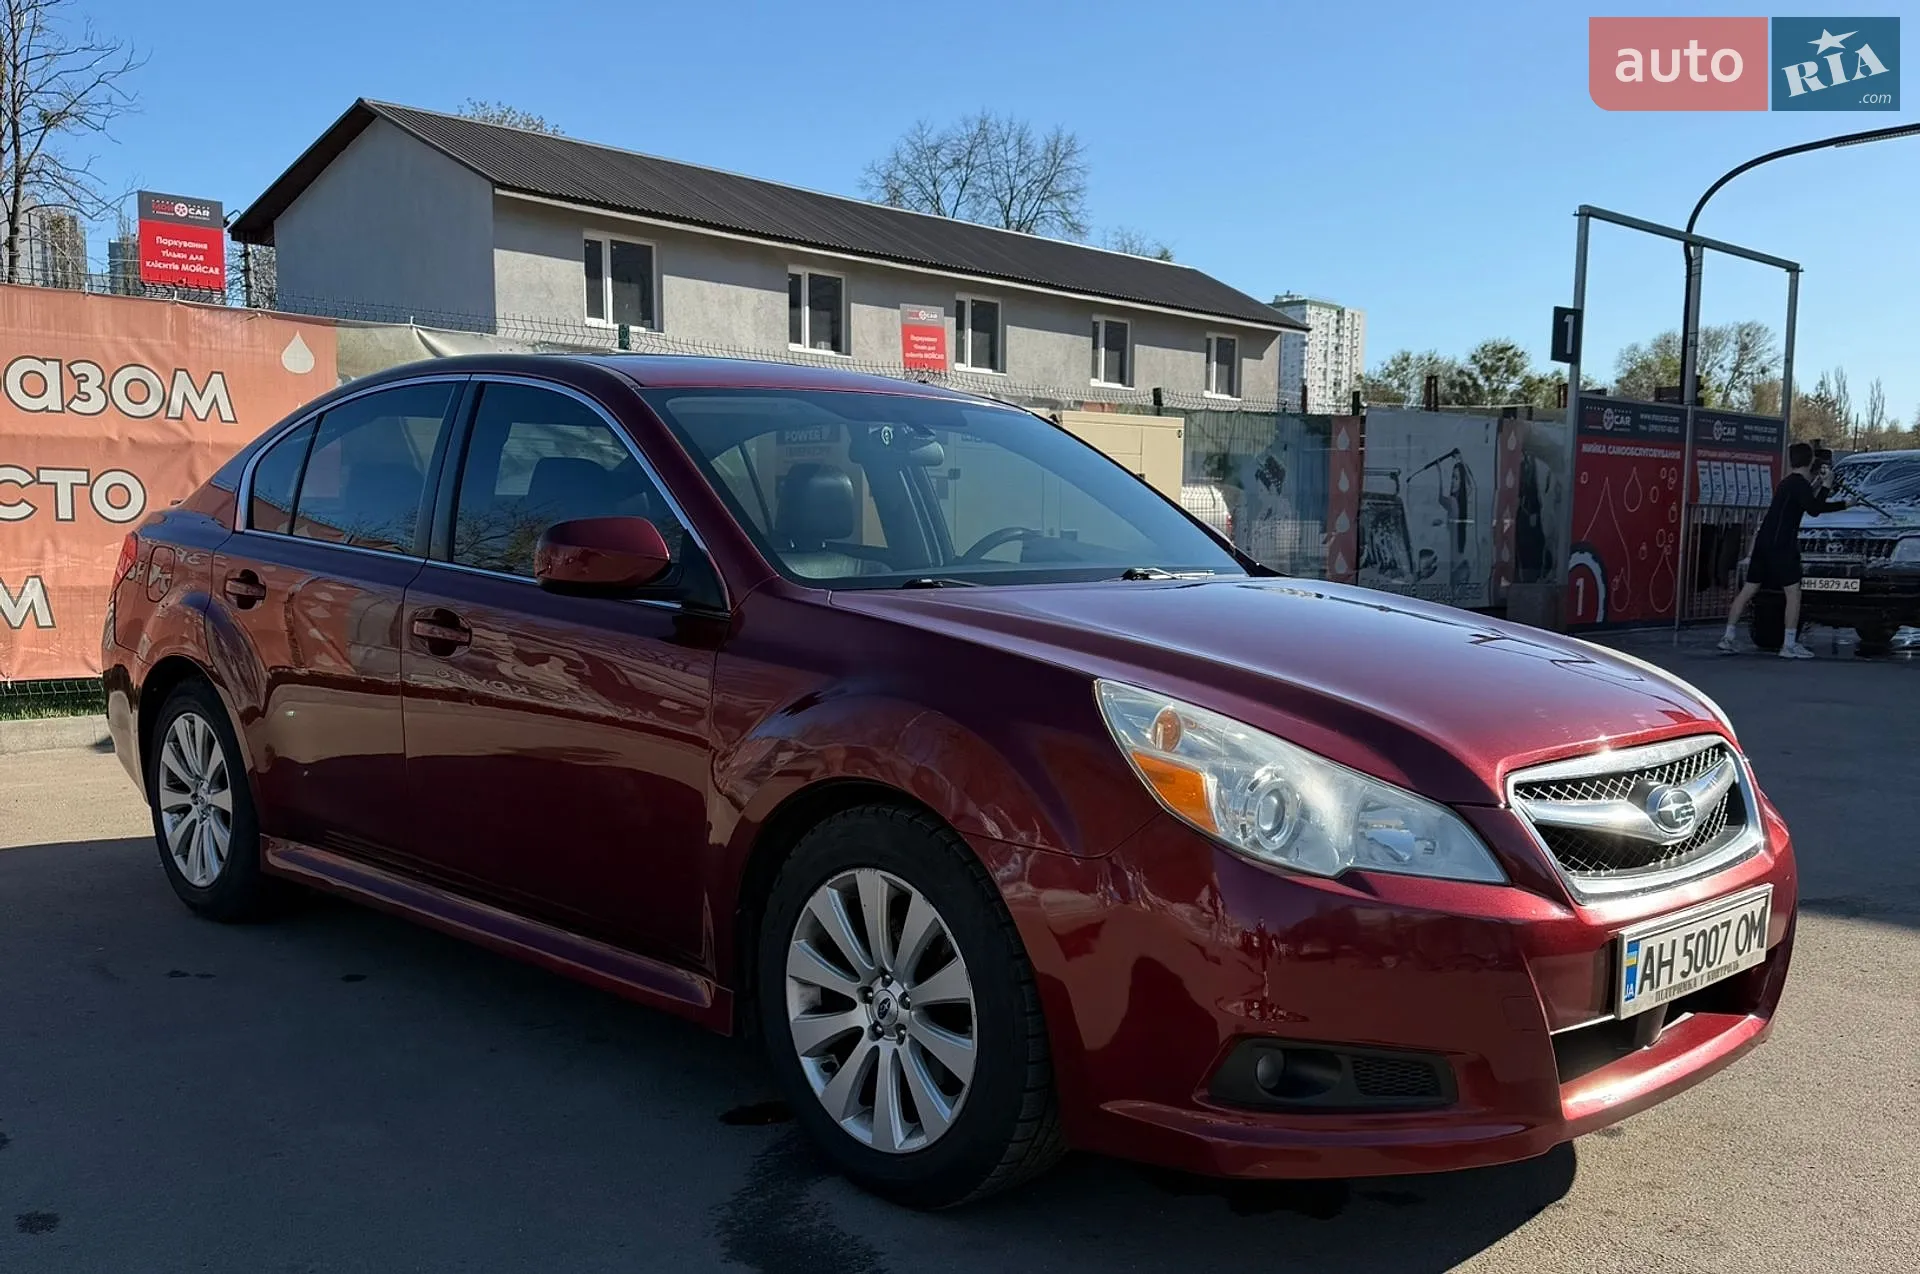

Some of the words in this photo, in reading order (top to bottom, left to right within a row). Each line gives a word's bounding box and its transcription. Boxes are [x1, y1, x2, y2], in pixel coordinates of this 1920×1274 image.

[188, 207, 210, 216] CAR
[156, 236, 208, 250] Паркування
[161, 249, 187, 260] тільки
[1563, 314, 1575, 354] 1
[0, 354, 238, 425] азом
[1614, 415, 1632, 426] CAR
[1843, 580, 1858, 590] AC
[1576, 577, 1585, 616] 1
[1637, 939, 1677, 995] AH
[1680, 919, 1732, 978] 5007
[1735, 906, 1766, 957] OM
